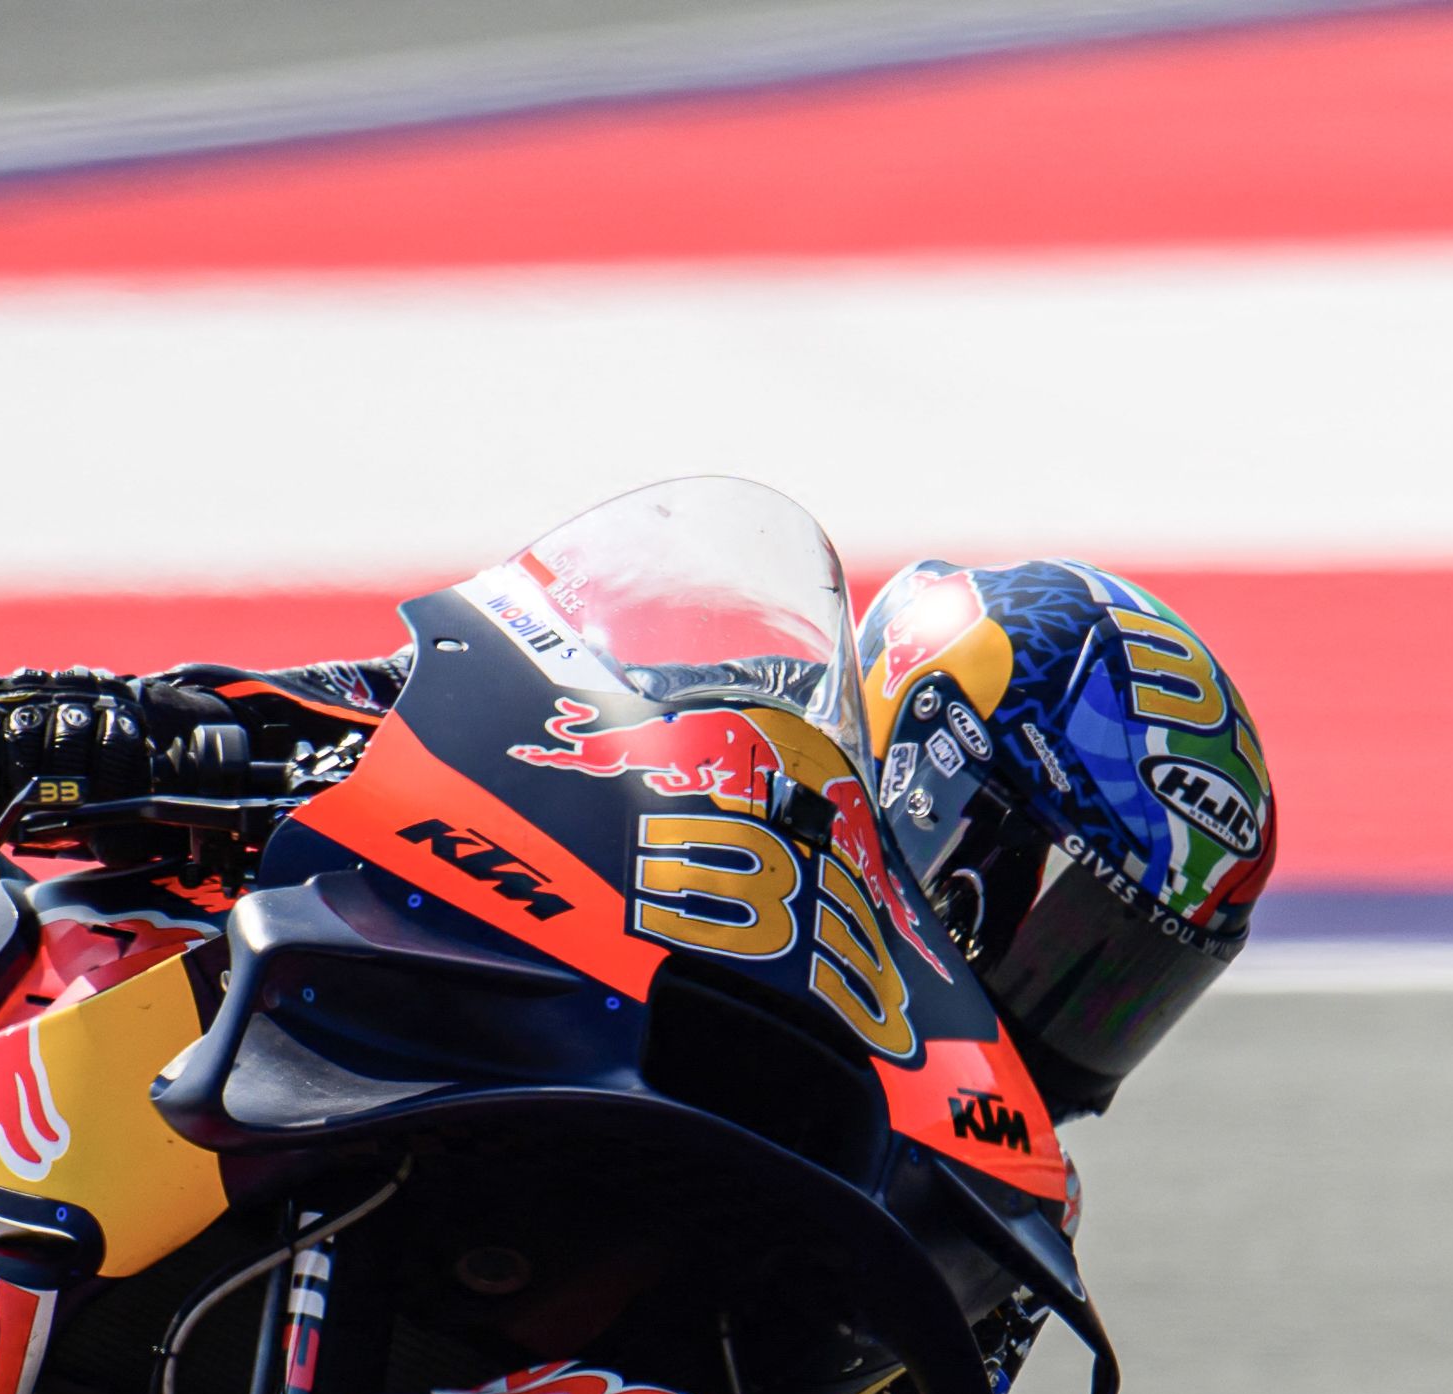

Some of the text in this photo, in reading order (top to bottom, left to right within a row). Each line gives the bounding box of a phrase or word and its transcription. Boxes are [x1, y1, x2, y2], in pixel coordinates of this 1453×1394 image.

[487, 595, 546, 637] Mobil
[548, 580, 585, 615] RACE
[952, 708, 987, 754] HJC
[40, 782, 79, 803] 33
[1157, 766, 1256, 848] HJC
[396, 819, 576, 921] KTM
[1064, 834, 1138, 903] GIVES
[1148, 904, 1195, 944] YOU
[634, 813, 919, 1060] 33
[948, 1088, 1030, 1154] KTM
